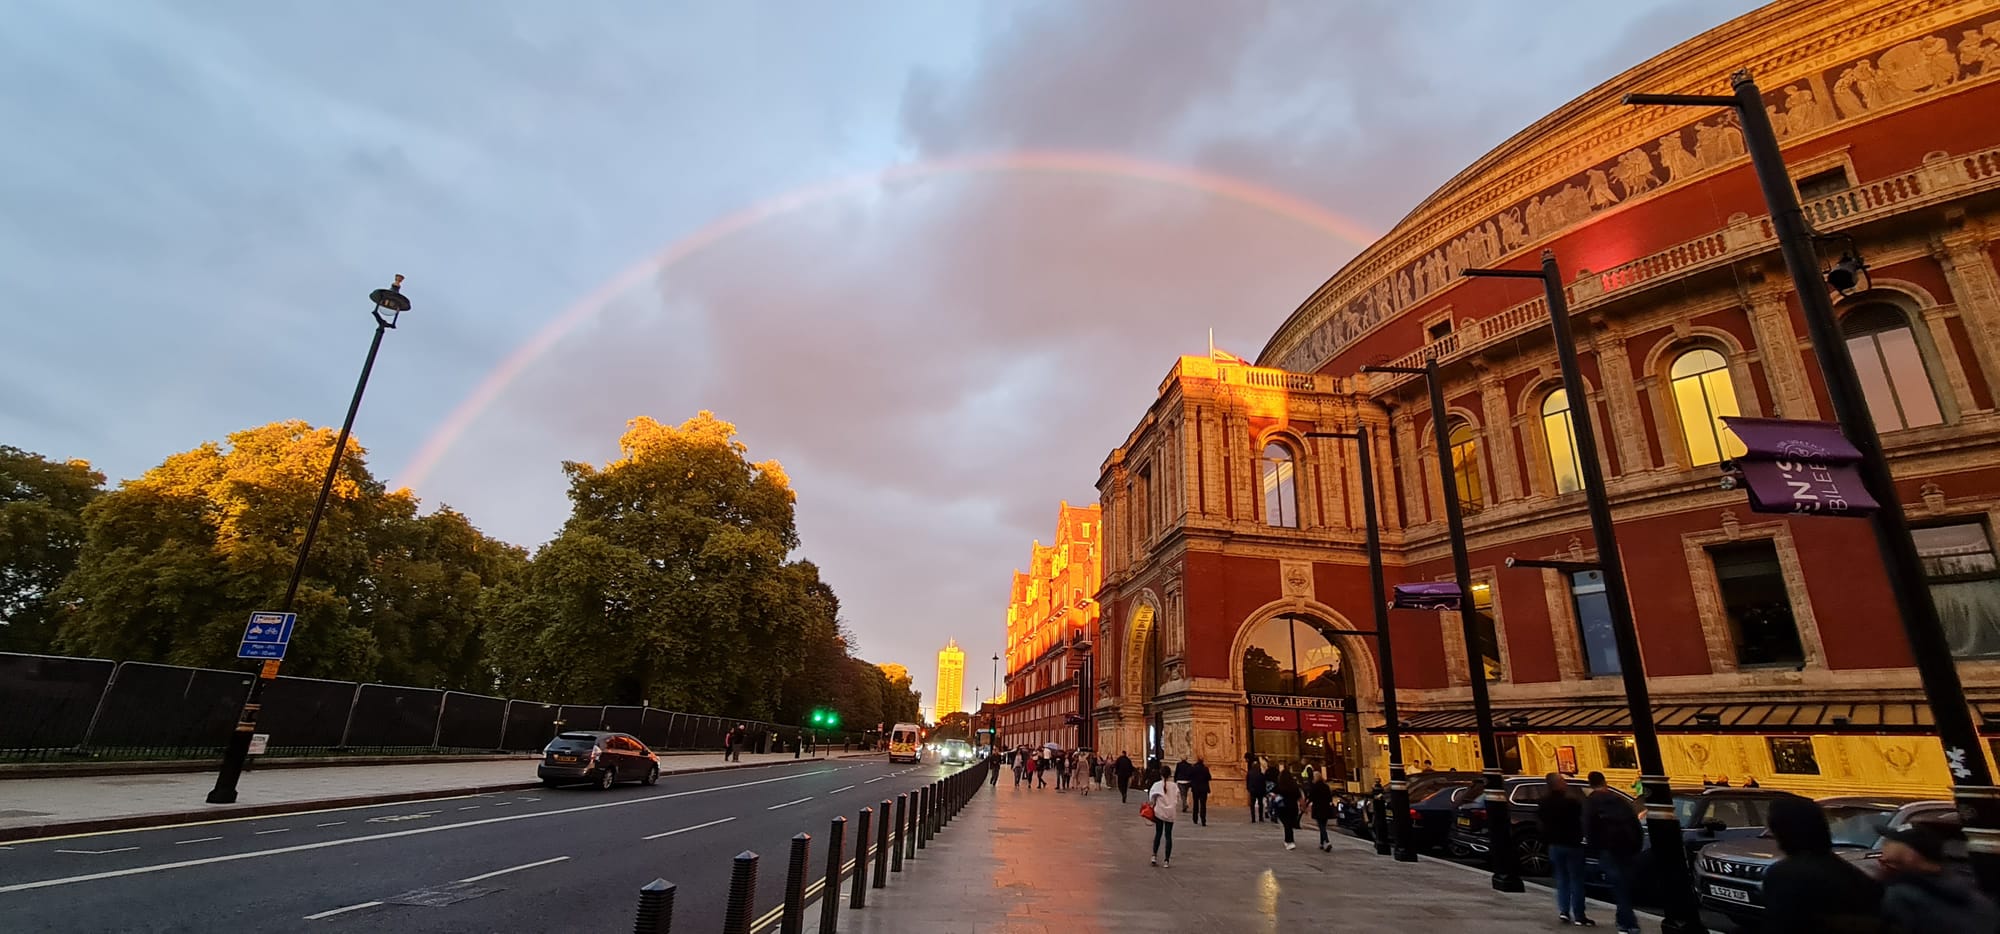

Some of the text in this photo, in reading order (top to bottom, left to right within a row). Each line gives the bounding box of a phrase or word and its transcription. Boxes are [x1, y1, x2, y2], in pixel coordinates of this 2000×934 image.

[1804, 53, 1838, 70] AND
[1652, 117, 1679, 133] AND
[1251, 695, 1344, 709] ROYAL ALBERT HALL
